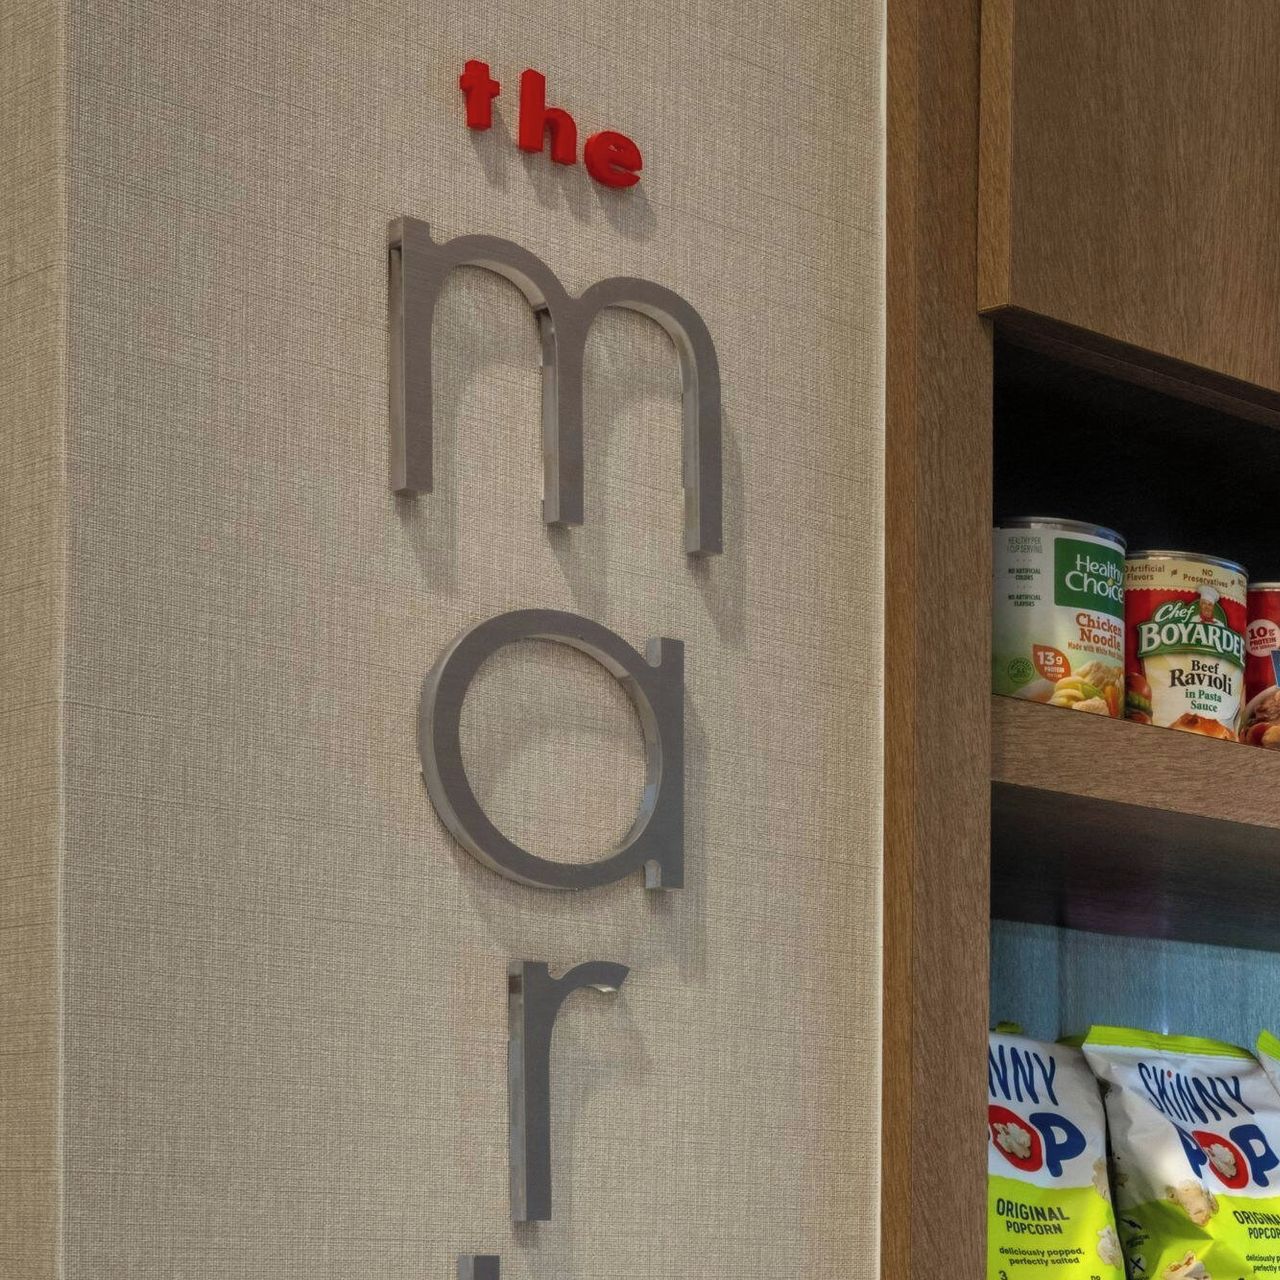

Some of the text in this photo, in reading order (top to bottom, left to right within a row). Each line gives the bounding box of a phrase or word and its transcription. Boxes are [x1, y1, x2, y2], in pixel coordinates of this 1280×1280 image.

[459, 58, 643, 189] the
[1075, 553, 1124, 586] Healthy
[1065, 571, 1124, 605] Choice
[1075, 612, 1122, 638] Chicken
[1154, 602, 1196, 623] Chef
[1079, 627, 1122, 651] Noodle
[1191, 659, 1219, 675] Beef
[1170, 668, 1233, 697] Ravioli
[1185, 688, 1223, 703] in Pasta
[1190, 700, 1218, 713] Sauce
[988, 1104, 1087, 1178] OP
[1171, 1120, 1280, 1190] POP
[996, 1198, 1070, 1223] ORIGINAL
[1006, 1220, 1064, 1236] POPCORN
